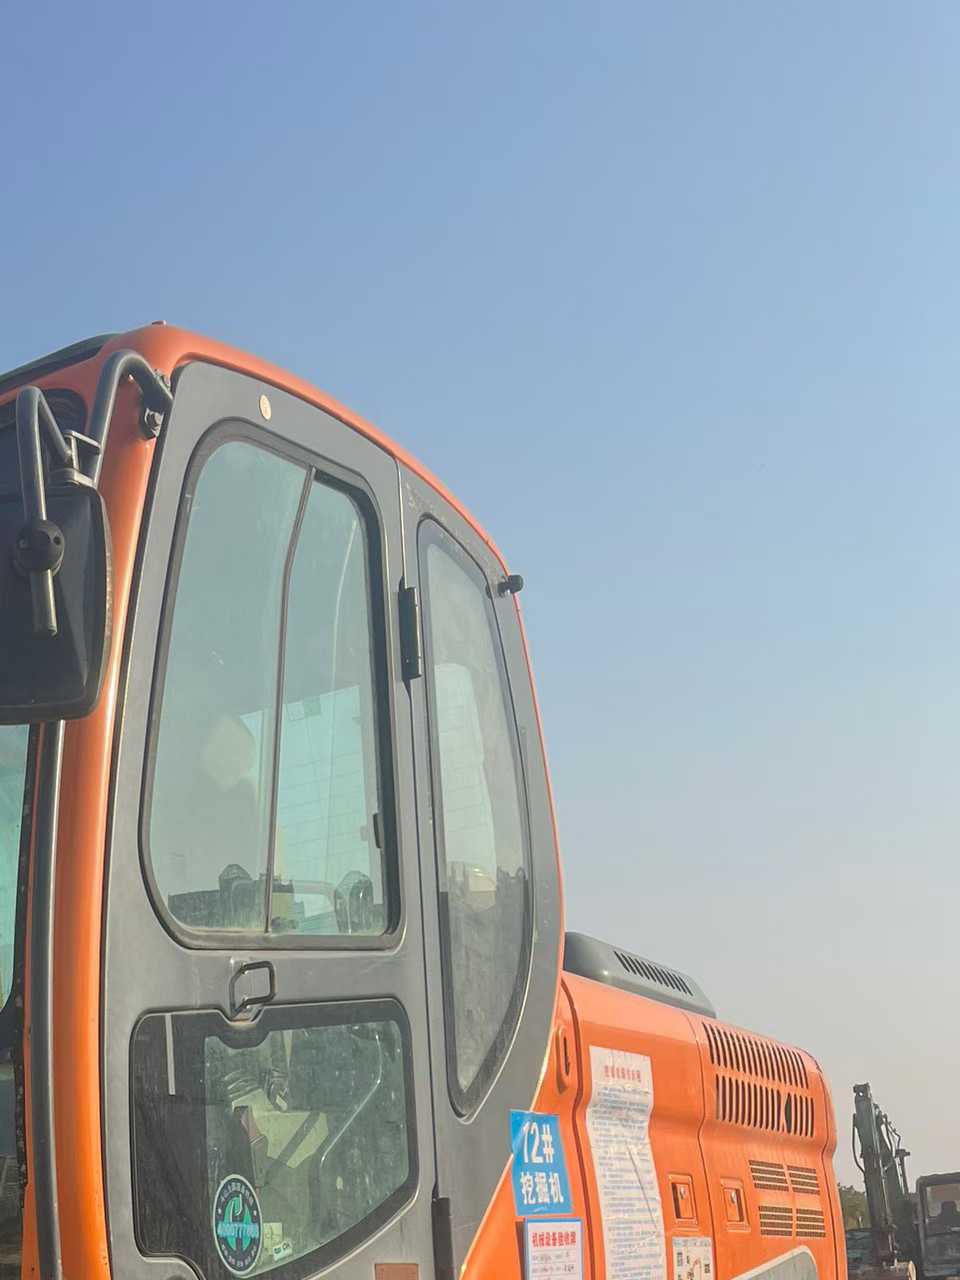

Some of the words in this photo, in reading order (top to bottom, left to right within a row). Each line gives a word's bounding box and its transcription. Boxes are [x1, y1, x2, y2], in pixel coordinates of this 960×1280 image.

[522, 1121, 555, 1163] 12#
[519, 1171, 564, 1205] 挖掘机
